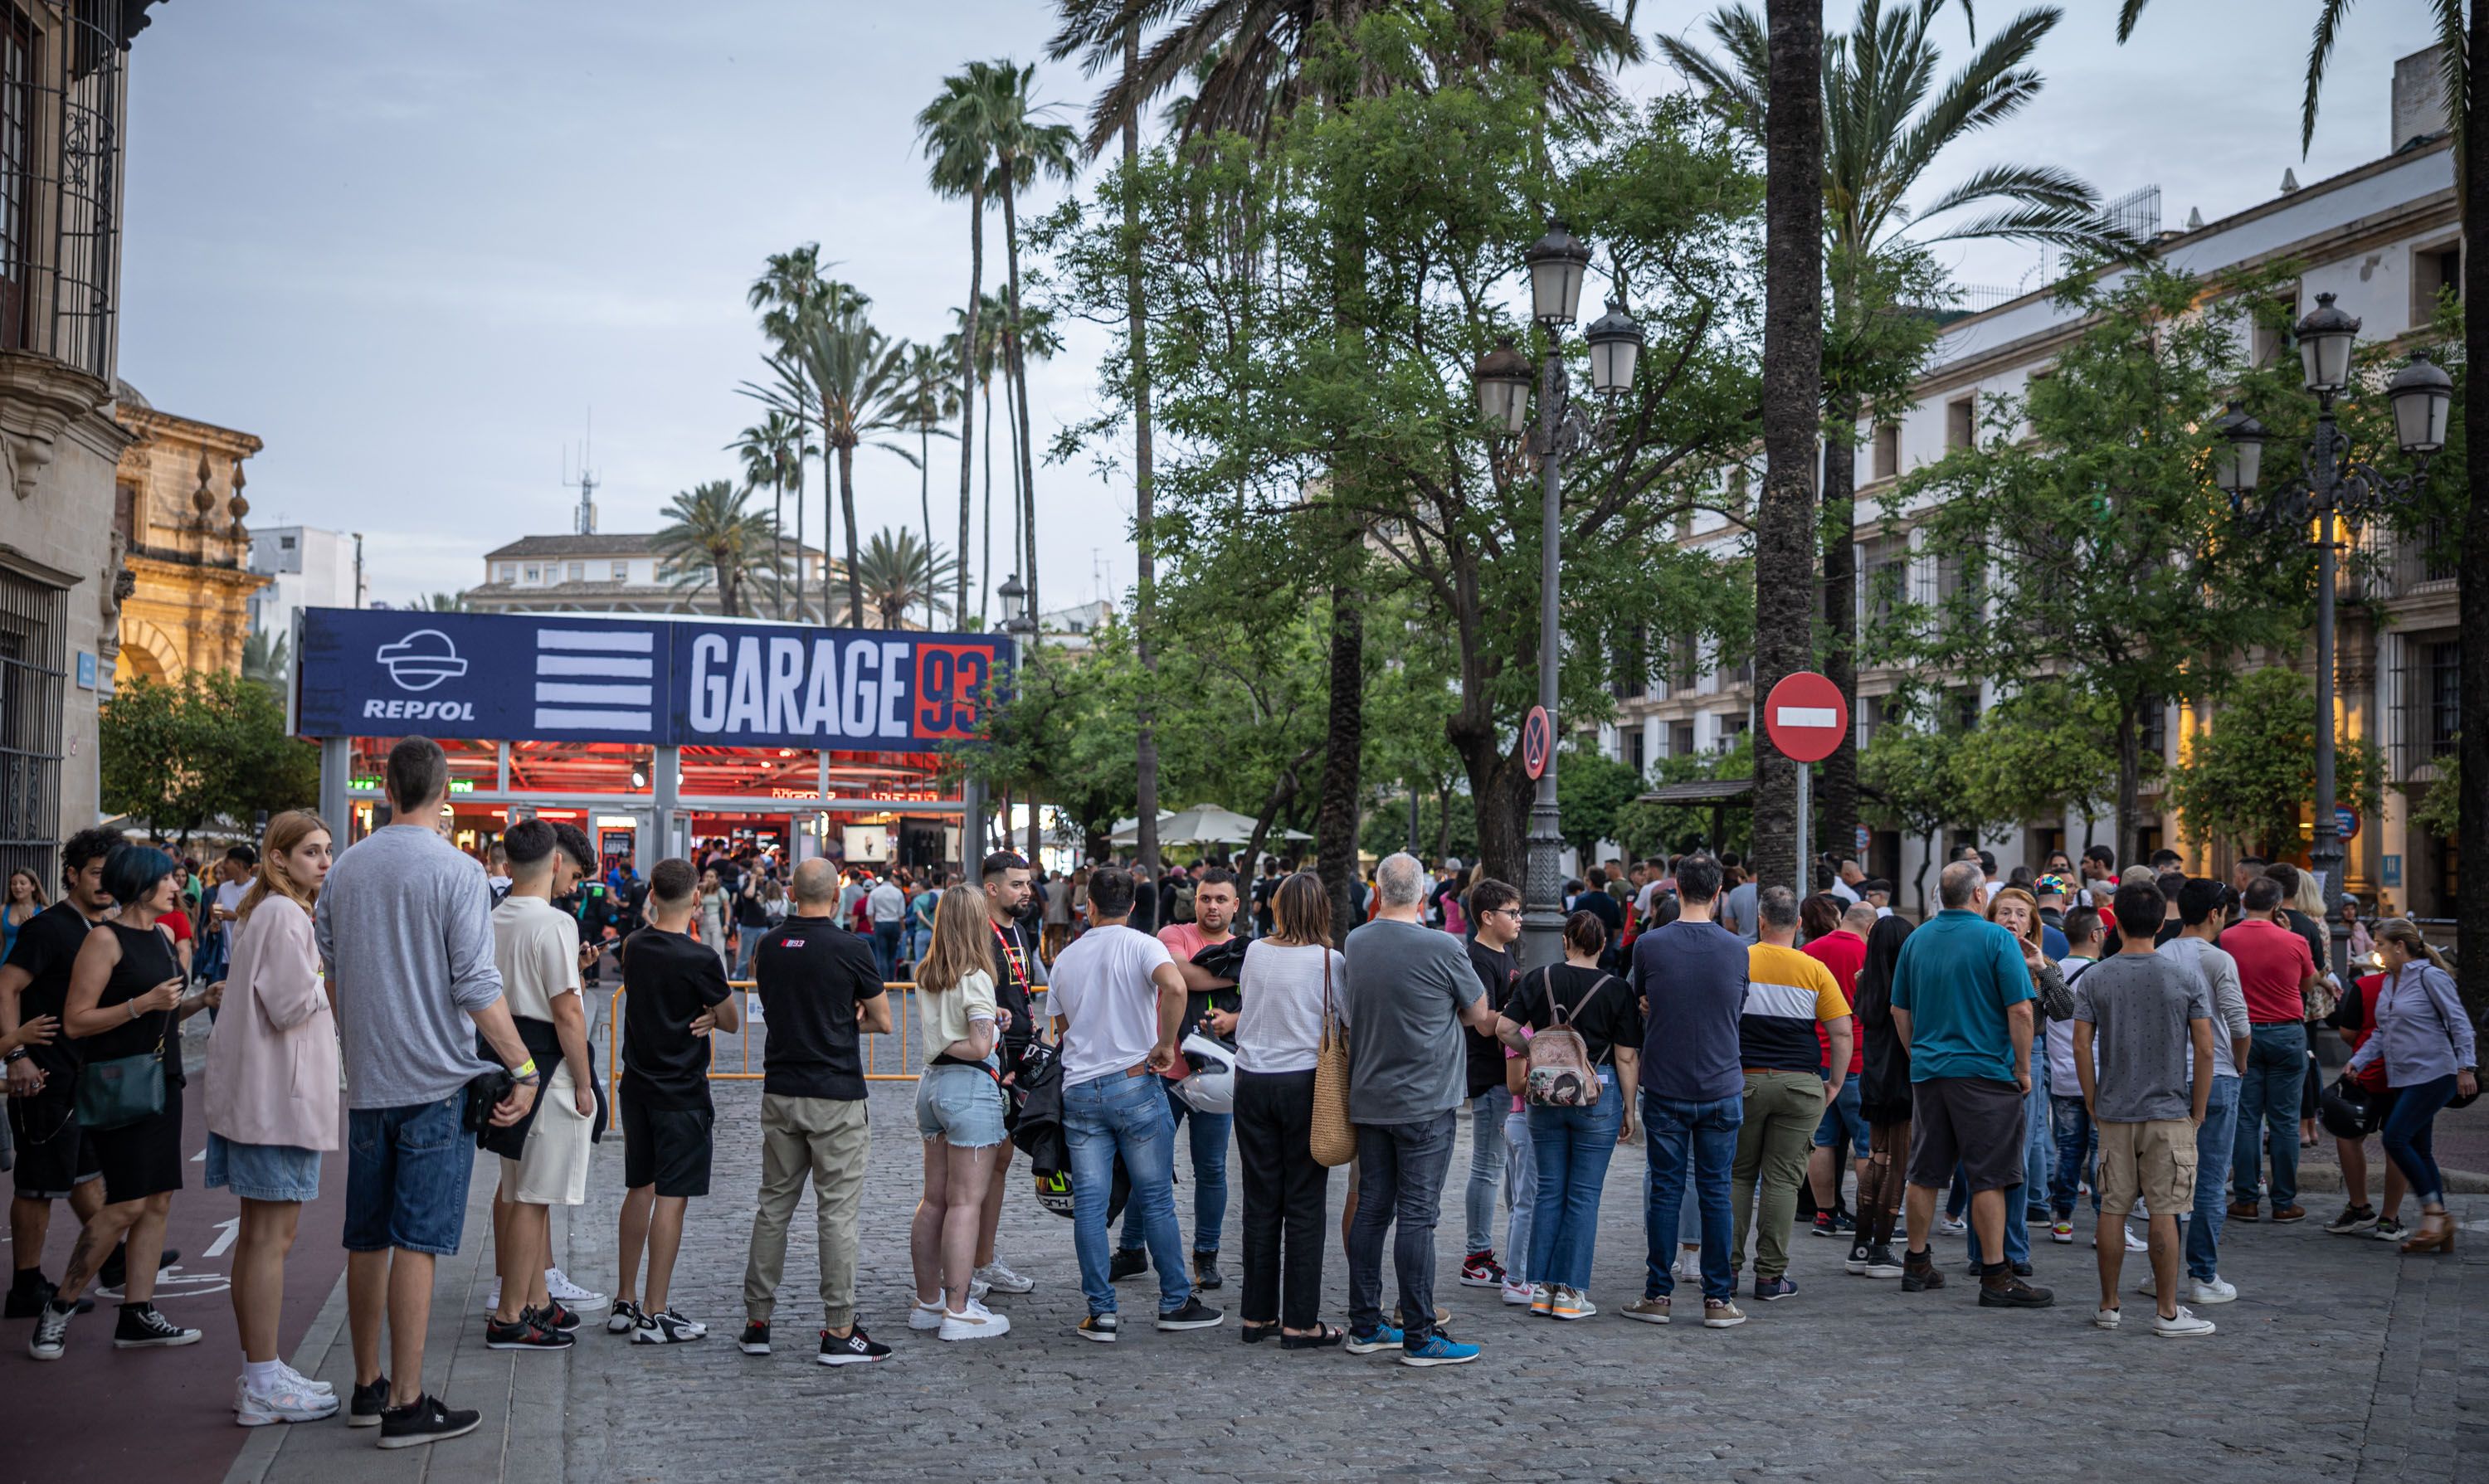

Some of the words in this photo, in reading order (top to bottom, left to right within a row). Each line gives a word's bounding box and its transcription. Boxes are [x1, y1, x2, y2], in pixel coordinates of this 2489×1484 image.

[689, 633, 909, 737] GARAGE
[921, 650, 988, 733] 93
[363, 698, 475, 721] REPSOL
[849, 1336, 868, 1353] 93
